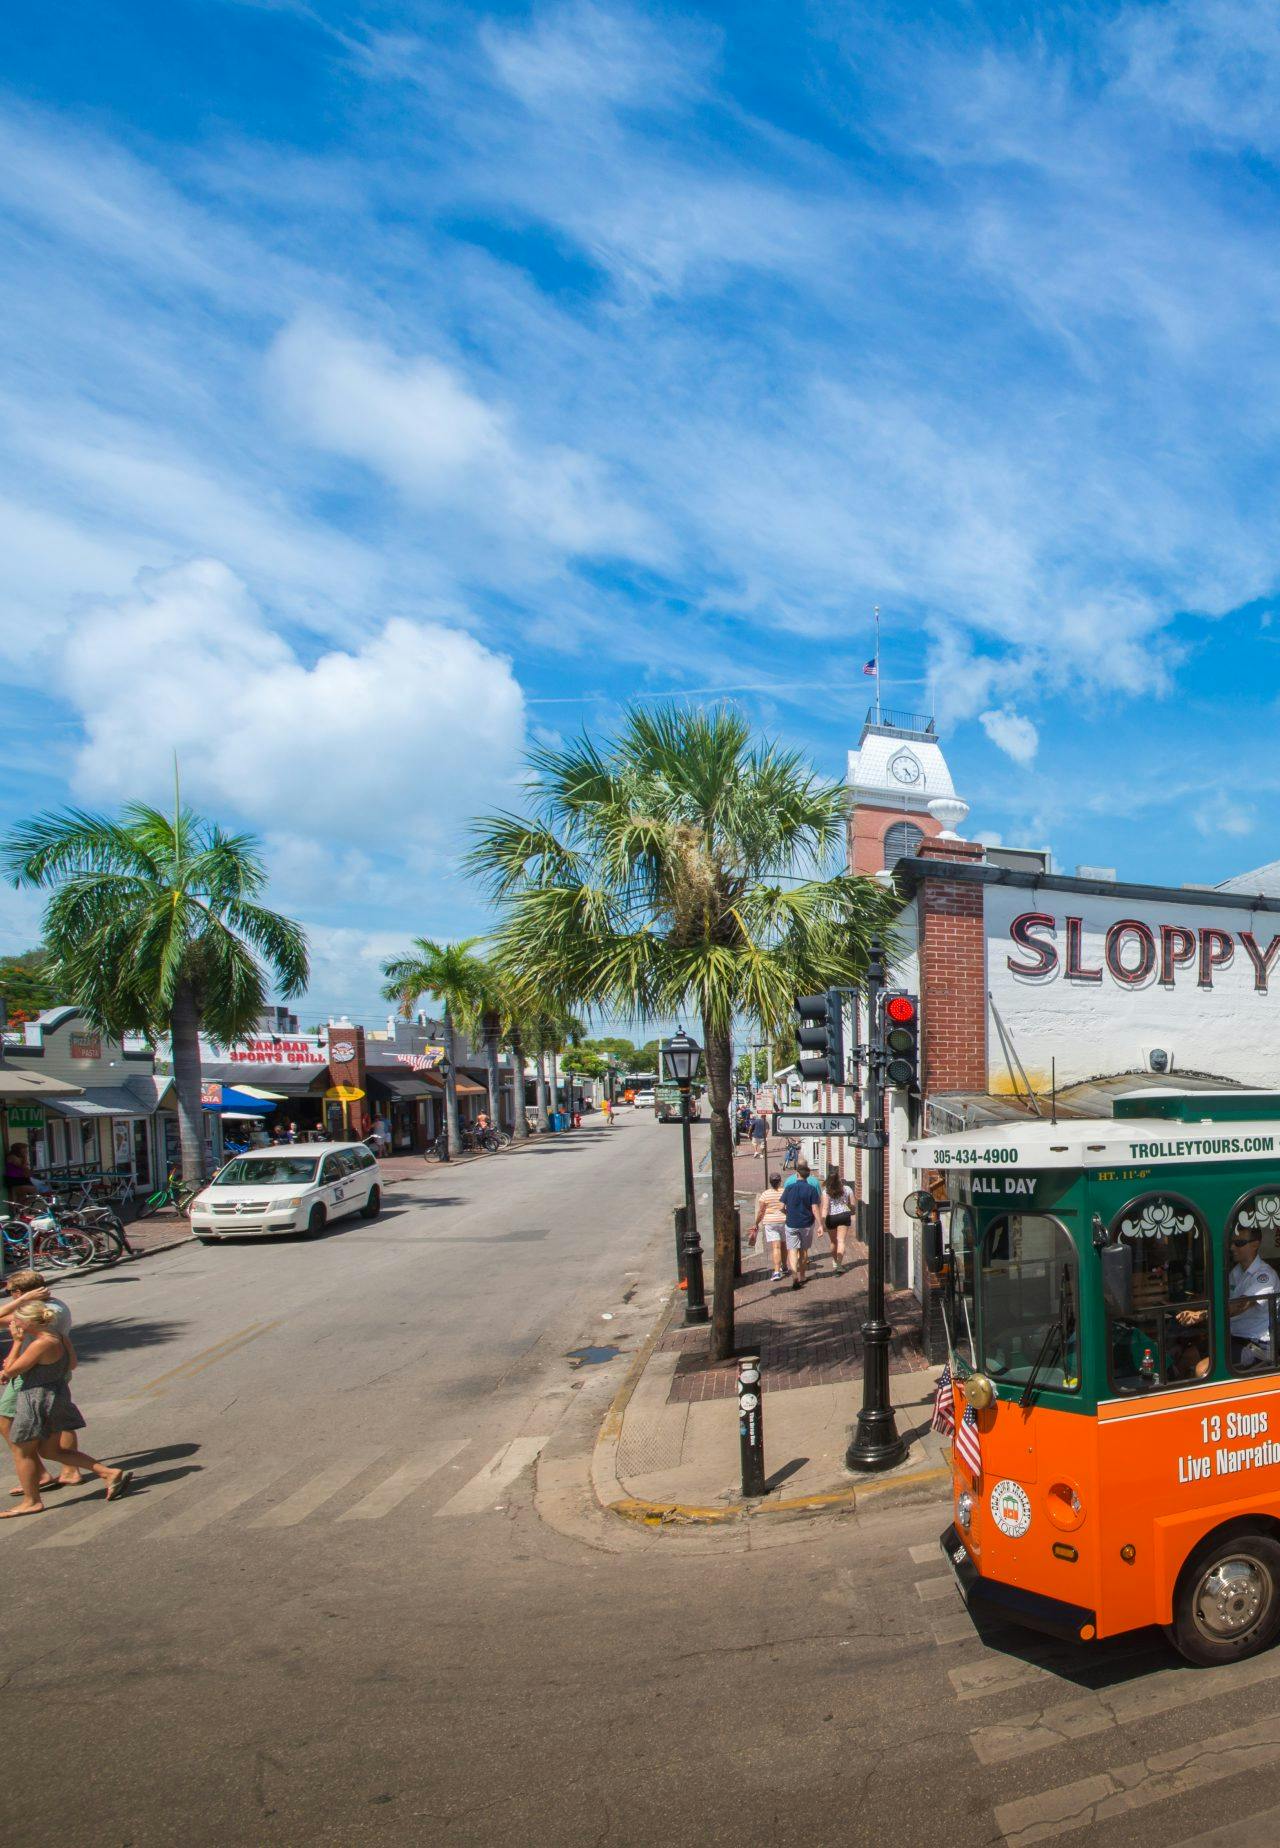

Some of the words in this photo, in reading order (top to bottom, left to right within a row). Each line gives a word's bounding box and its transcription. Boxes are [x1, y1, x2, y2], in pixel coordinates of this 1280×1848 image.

[230, 1051, 282, 1063] SPORTS
[287, 1053, 326, 1064] GRILL
[10, 1107, 42, 1121] ATM
[792, 1119, 826, 1130] Duval
[830, 1119, 841, 1130] St
[933, 1148, 1019, 1165] 305-434-4900
[1129, 1137, 1275, 1159] TROLLEYTOURS.COM
[971, 1177, 1001, 1194] ALL
[1005, 1178, 1038, 1194] DAY
[1200, 1414, 1222, 1444] 13
[1226, 1411, 1269, 1440] Stops
[1178, 1454, 1212, 1484] Live
[994, 1481, 1010, 1496] TOWN
[991, 1494, 999, 1511] OLD
[1012, 1483, 1031, 1520] TROLLEY
[998, 1516, 1026, 1537] TOURS
